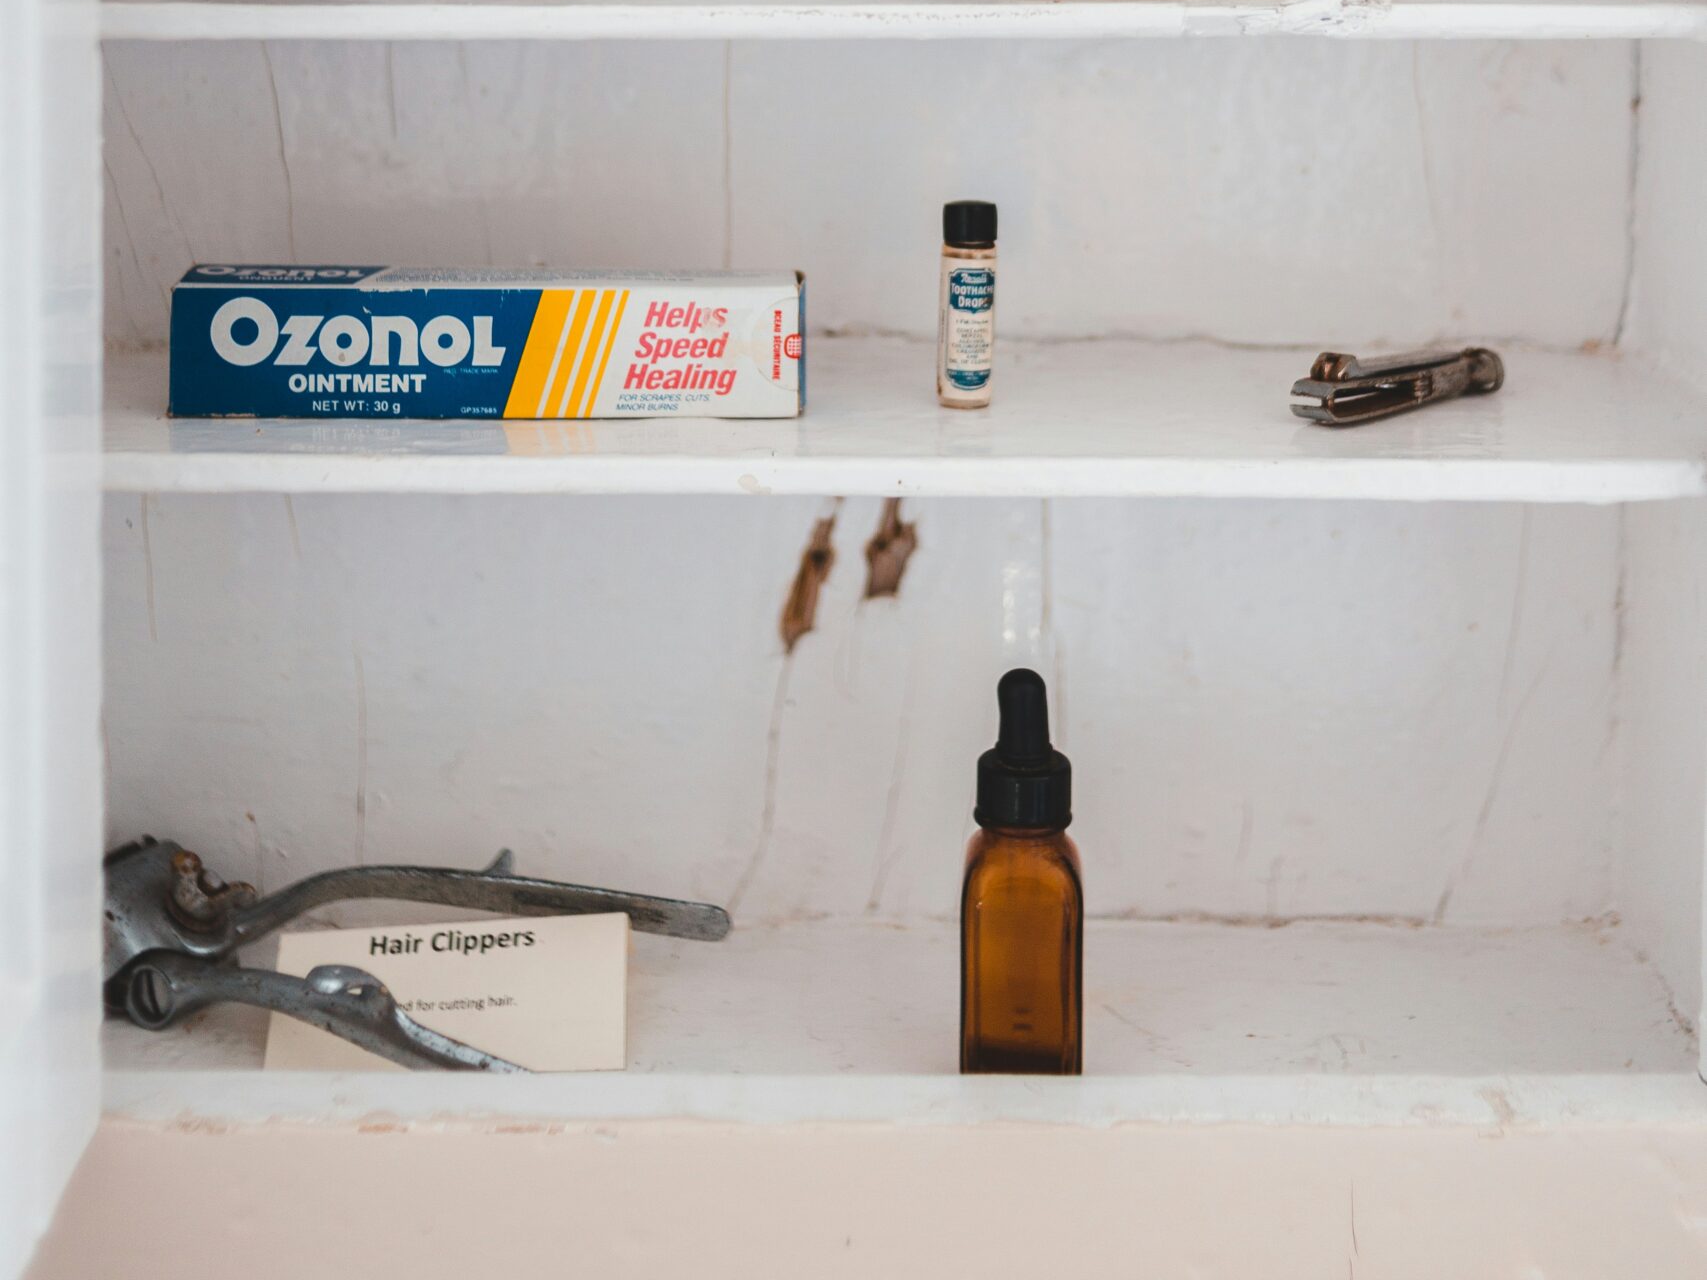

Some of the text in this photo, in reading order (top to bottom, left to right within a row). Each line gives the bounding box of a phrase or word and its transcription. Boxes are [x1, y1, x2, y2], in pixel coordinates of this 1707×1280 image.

[951, 283, 994, 295] TOOTHACH
[644, 301, 729, 334] Helps
[634, 332, 729, 363] Speed
[288, 374, 427, 394] OINTMENT
[624, 364, 738, 396] Healing
[312, 400, 402, 415] NET WT: 30 g
[618, 394, 638, 402] FOR
[370, 930, 536, 957] Hair Clippers
[415, 1000, 435, 1012] for
[438, 997, 484, 1013] cutting
[487, 995, 518, 1008] hair.
